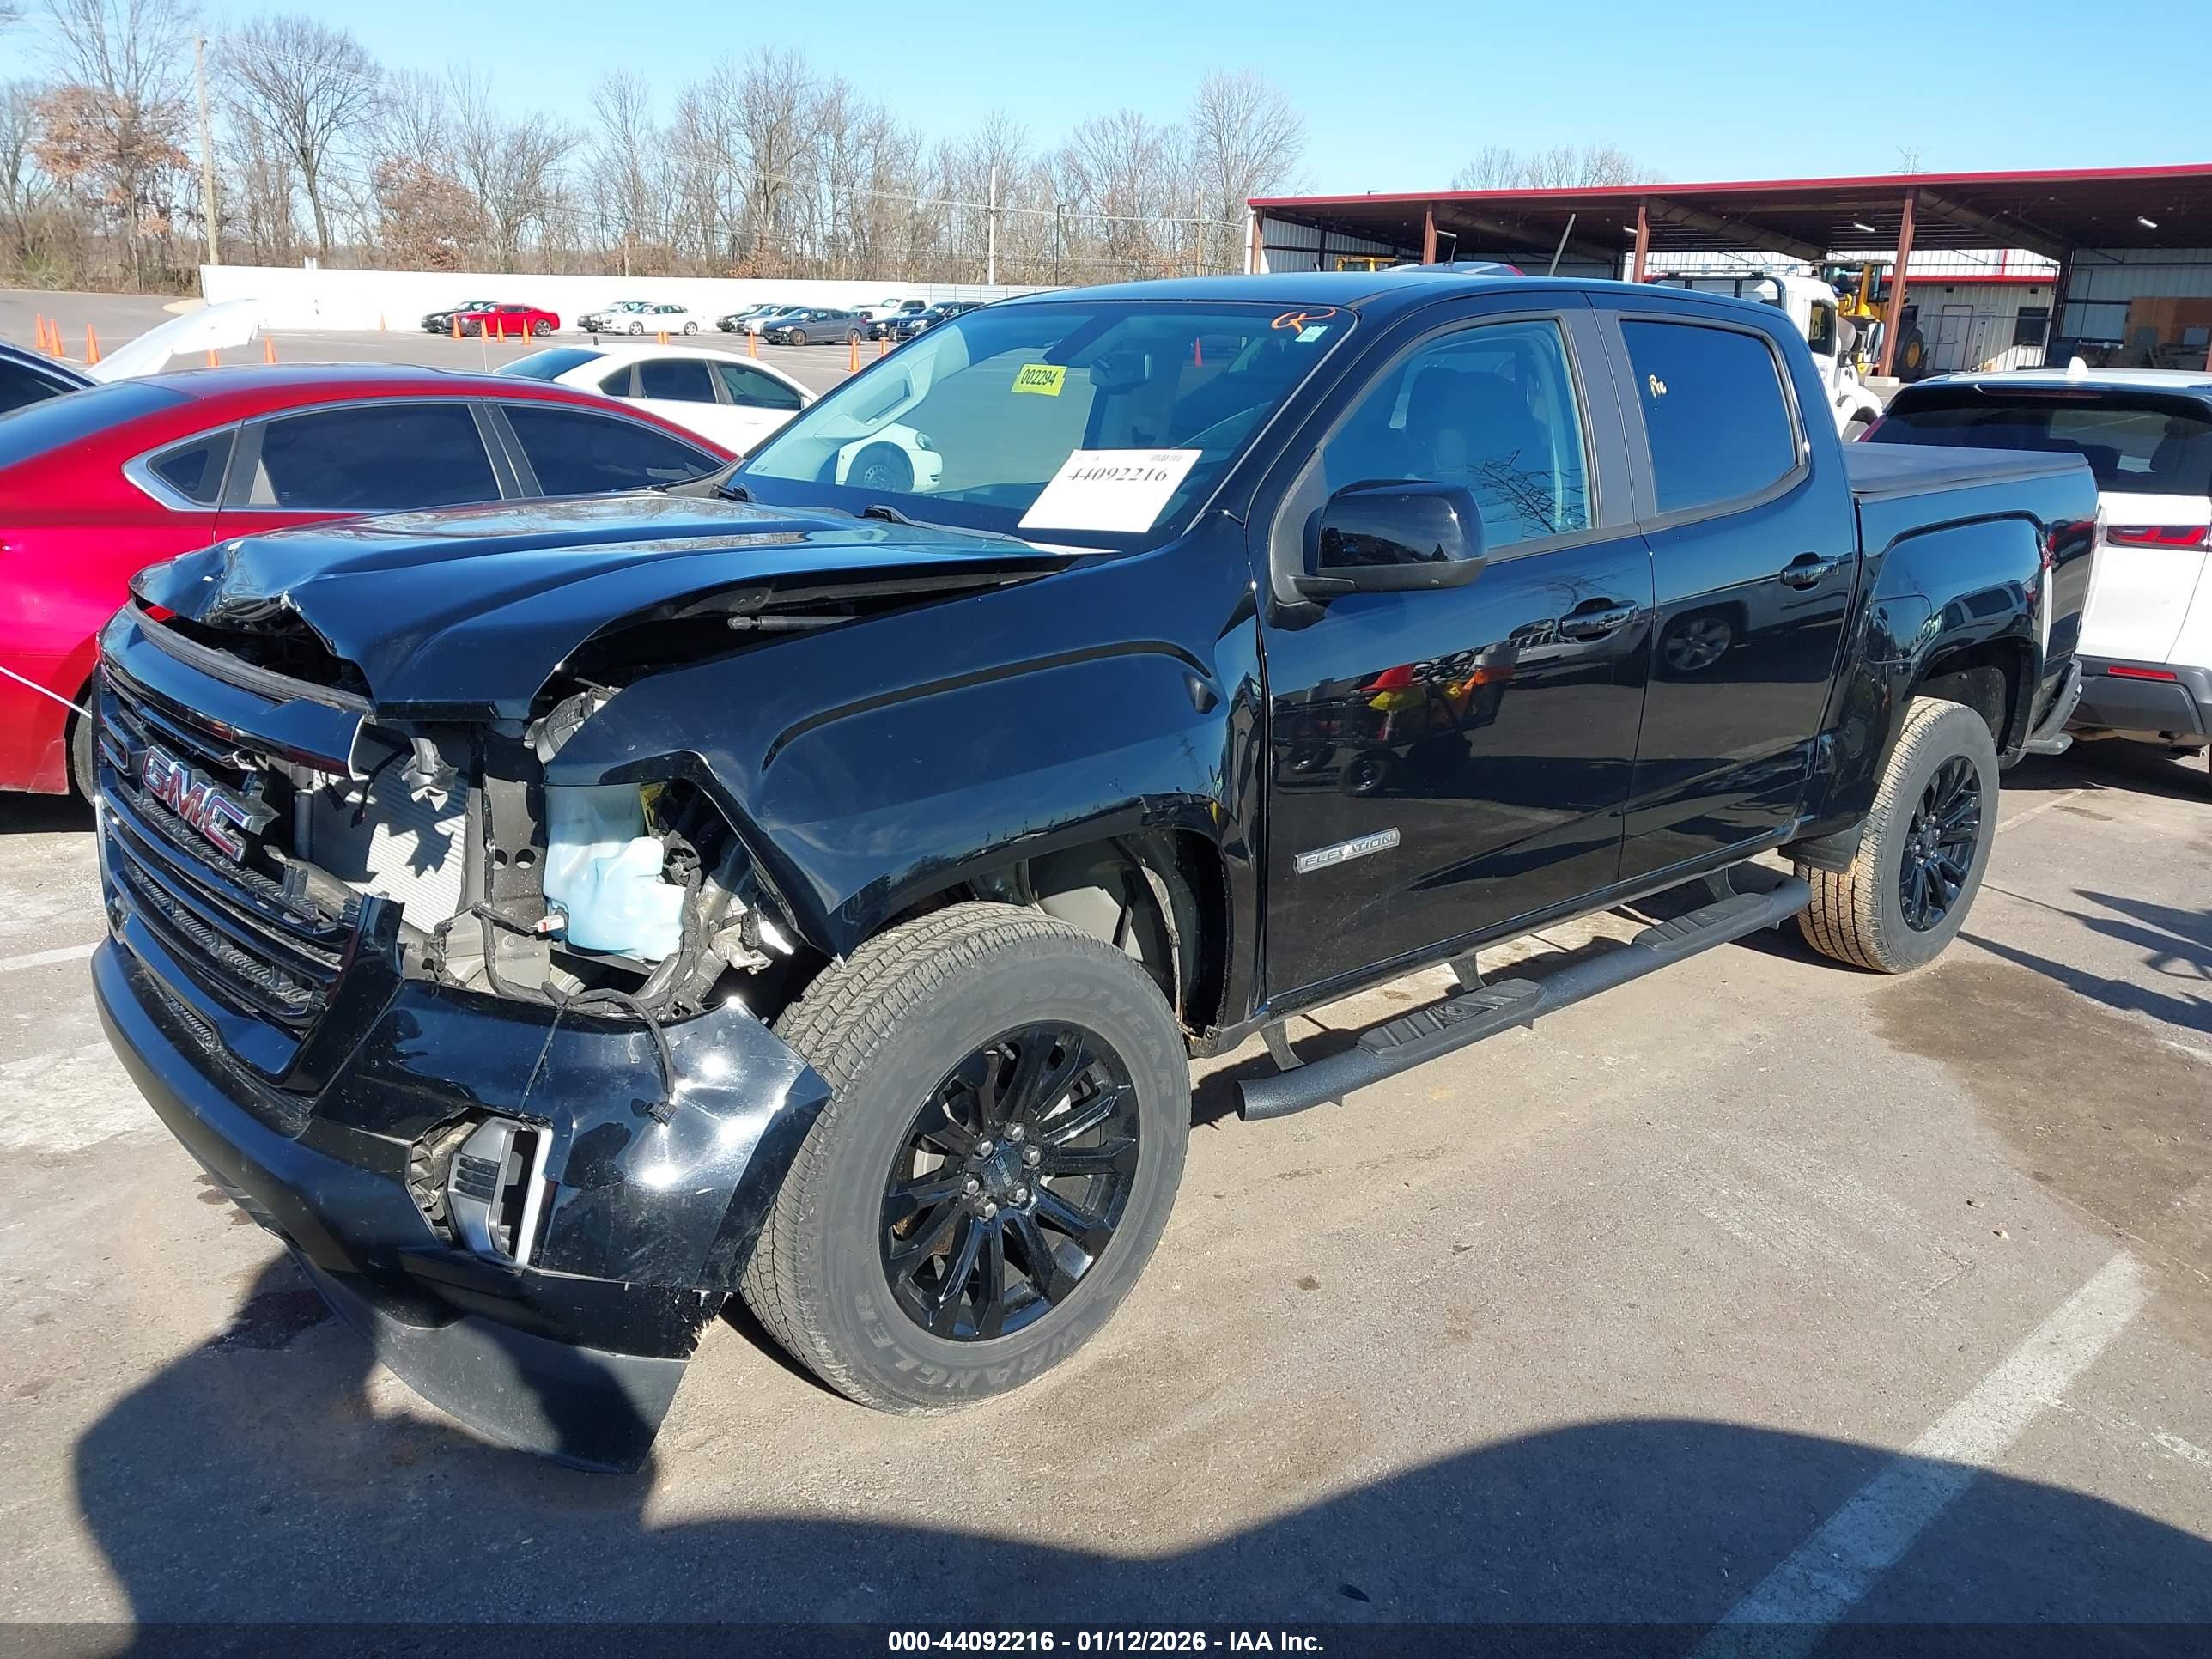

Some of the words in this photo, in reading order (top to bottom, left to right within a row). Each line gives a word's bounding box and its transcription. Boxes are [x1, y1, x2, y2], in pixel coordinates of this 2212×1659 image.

[1020, 368, 1059, 386] 002294
[1067, 467, 1168, 482] 44092216
[143, 745, 254, 861] GMC
[1304, 832, 1394, 867] ELEVATION
[854, 1291, 1085, 1389] WRANGLER
